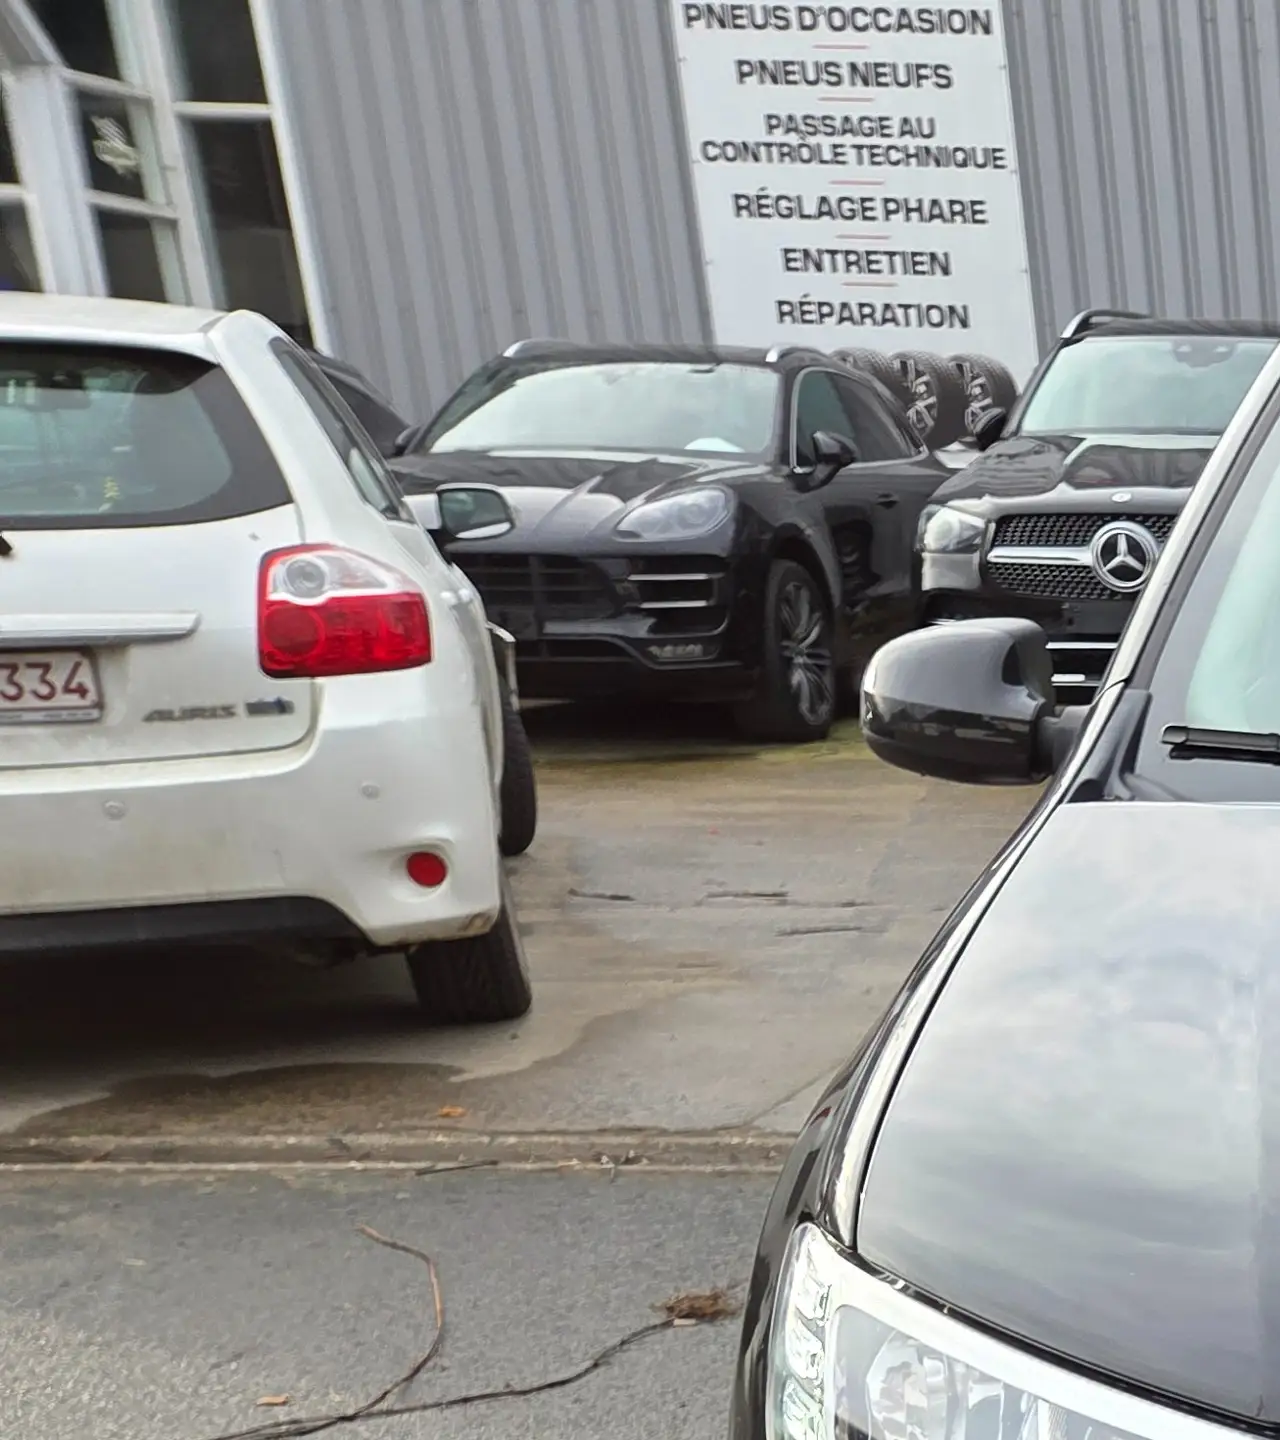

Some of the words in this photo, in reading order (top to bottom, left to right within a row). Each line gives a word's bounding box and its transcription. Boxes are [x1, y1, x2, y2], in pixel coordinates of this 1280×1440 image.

[684, 3, 792, 31] PNEUS
[800, 5, 993, 35] D'OCCASION
[735, 59, 843, 86] PNEUS
[849, 61, 953, 89] NEUFS
[765, 113, 893, 139] PASSAGE
[899, 116, 935, 139] AU
[701, 135, 848, 166] CONTRÔLE
[855, 144, 1008, 170] TECHNIQUE
[732, 187, 878, 222] RÉGLAGE
[883, 199, 989, 225] PHARE
[781, 247, 952, 277] ENTRETIEN
[776, 294, 971, 330] RÉPARATION
[0, 661, 90, 701] 334
[142, 705, 237, 722] AURIS
